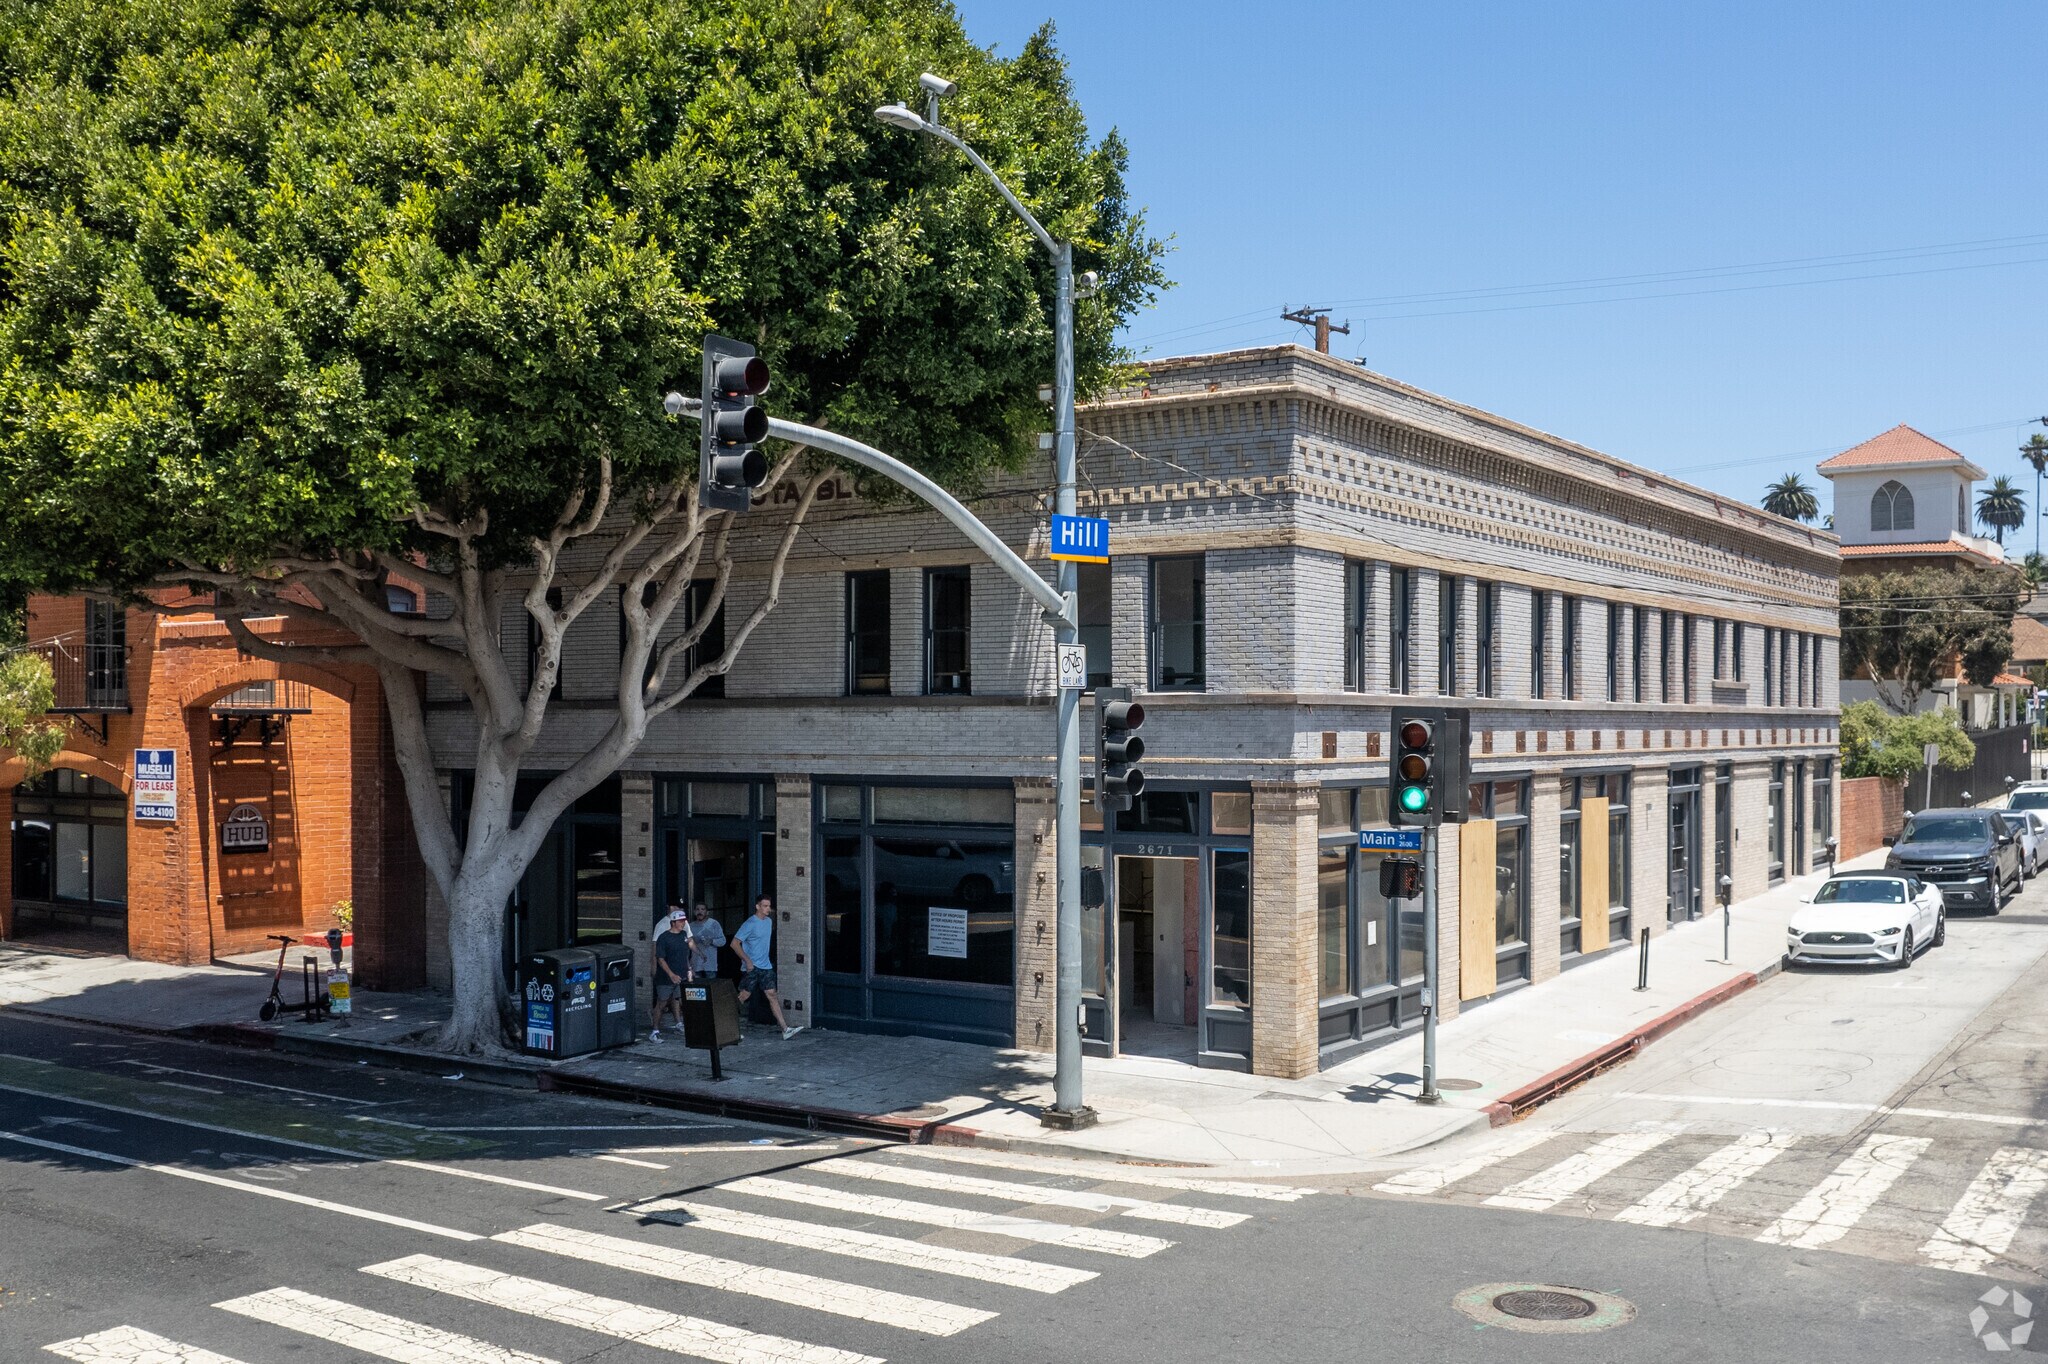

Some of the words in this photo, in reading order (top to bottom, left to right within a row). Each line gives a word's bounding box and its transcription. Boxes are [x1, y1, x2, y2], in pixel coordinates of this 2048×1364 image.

[1061, 520, 1099, 548] Hill
[1062, 676, 1072, 686] BIKE
[1073, 676, 1083, 686] LANE
[138, 763, 172, 775] MUSELLI
[136, 781, 149, 790] FOR
[151, 782, 174, 791] LEASE
[142, 807, 174, 817] 458-4100
[227, 826, 264, 842] HUB
[1362, 833, 1395, 846] Main
[1138, 844, 1173, 855] 2671
[565, 1003, 592, 1012] RECYCLING
